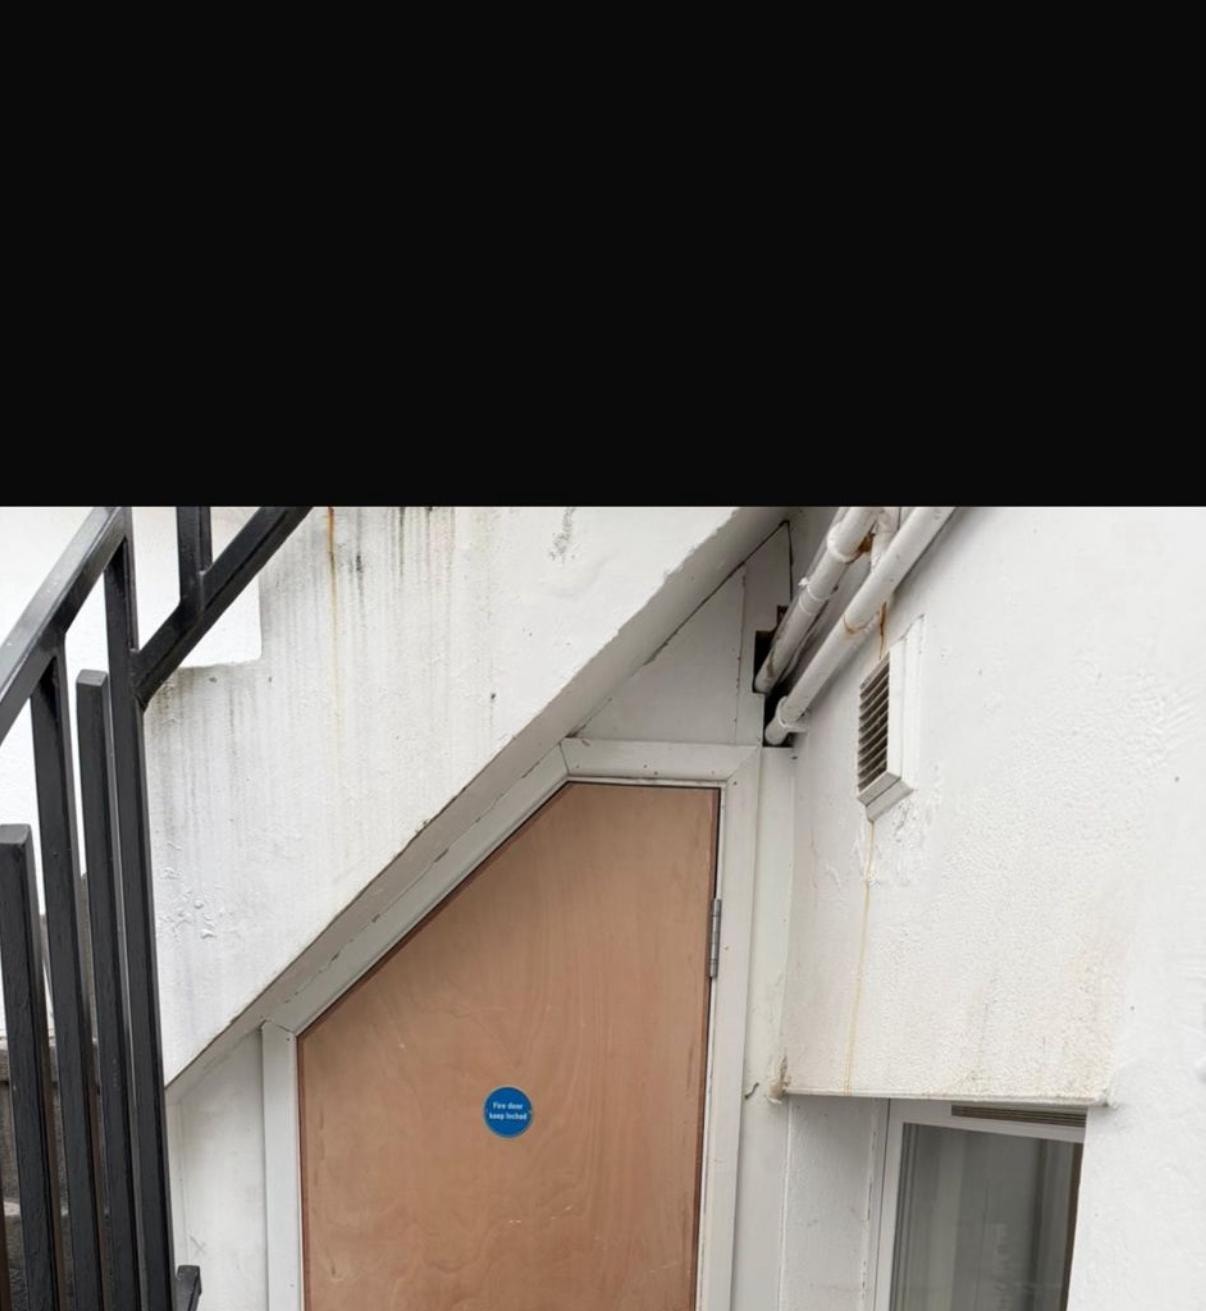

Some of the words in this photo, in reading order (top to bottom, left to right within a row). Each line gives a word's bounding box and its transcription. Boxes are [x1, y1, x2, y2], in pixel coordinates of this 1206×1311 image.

[492, 1101, 506, 1110] Fire
[507, 1101, 523, 1110] door
[489, 1111, 505, 1120] keep
[506, 1111, 527, 1120] locked
